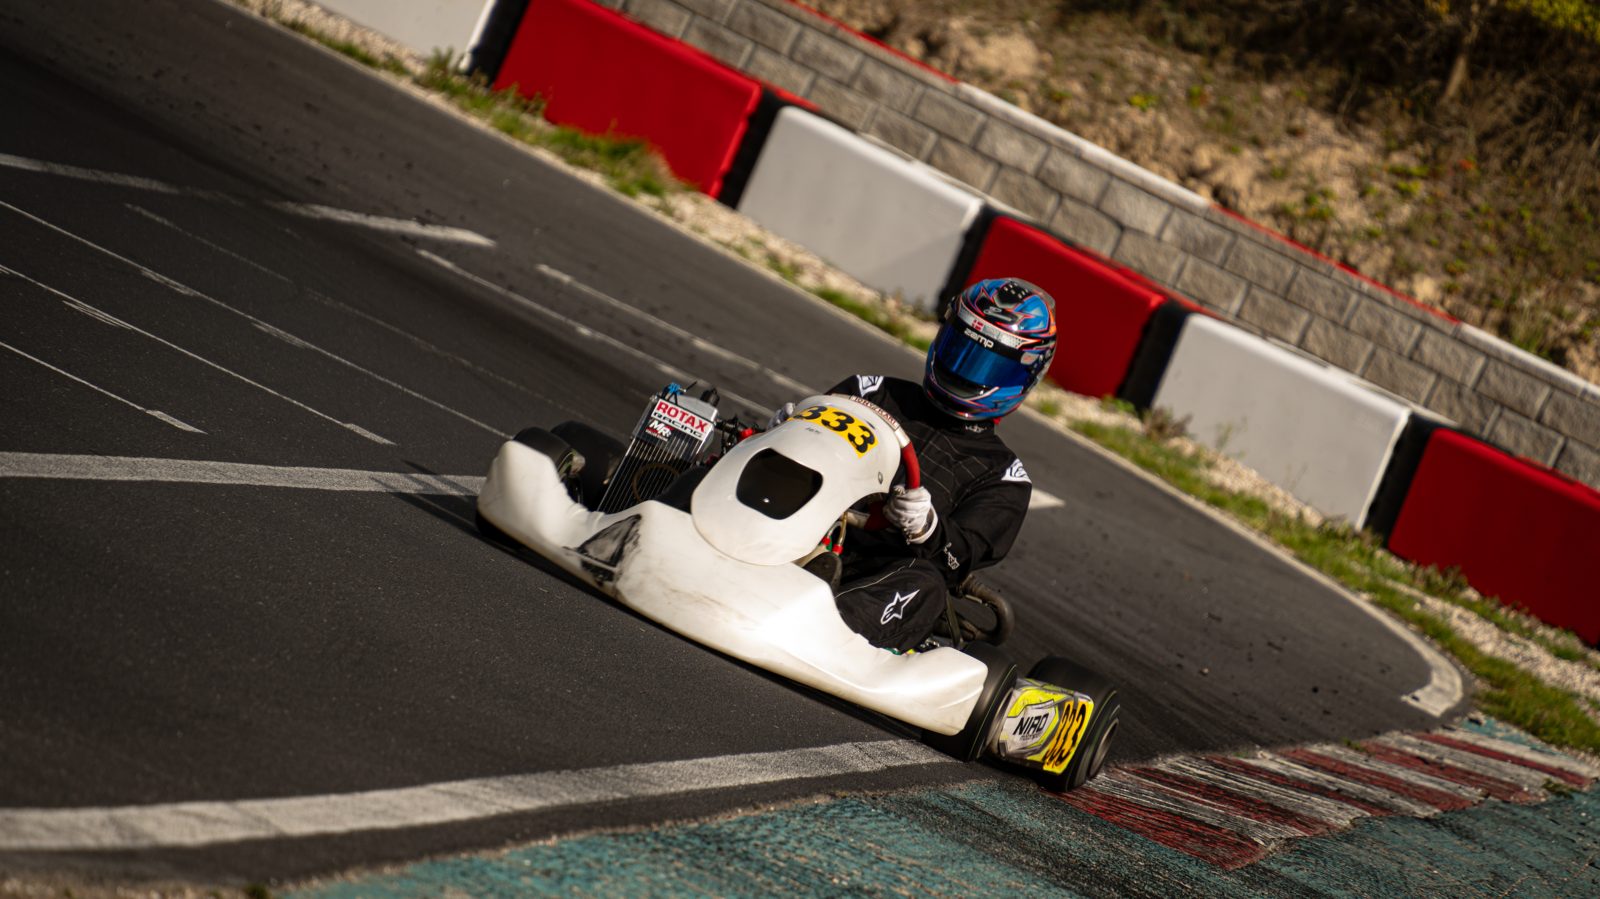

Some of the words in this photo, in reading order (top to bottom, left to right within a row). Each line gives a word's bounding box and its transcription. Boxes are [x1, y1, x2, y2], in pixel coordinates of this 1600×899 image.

[964, 327, 994, 349] zamp
[656, 400, 710, 432] ROTAX
[793, 405, 875, 454] 333
[1013, 713, 1050, 736] NIRO
